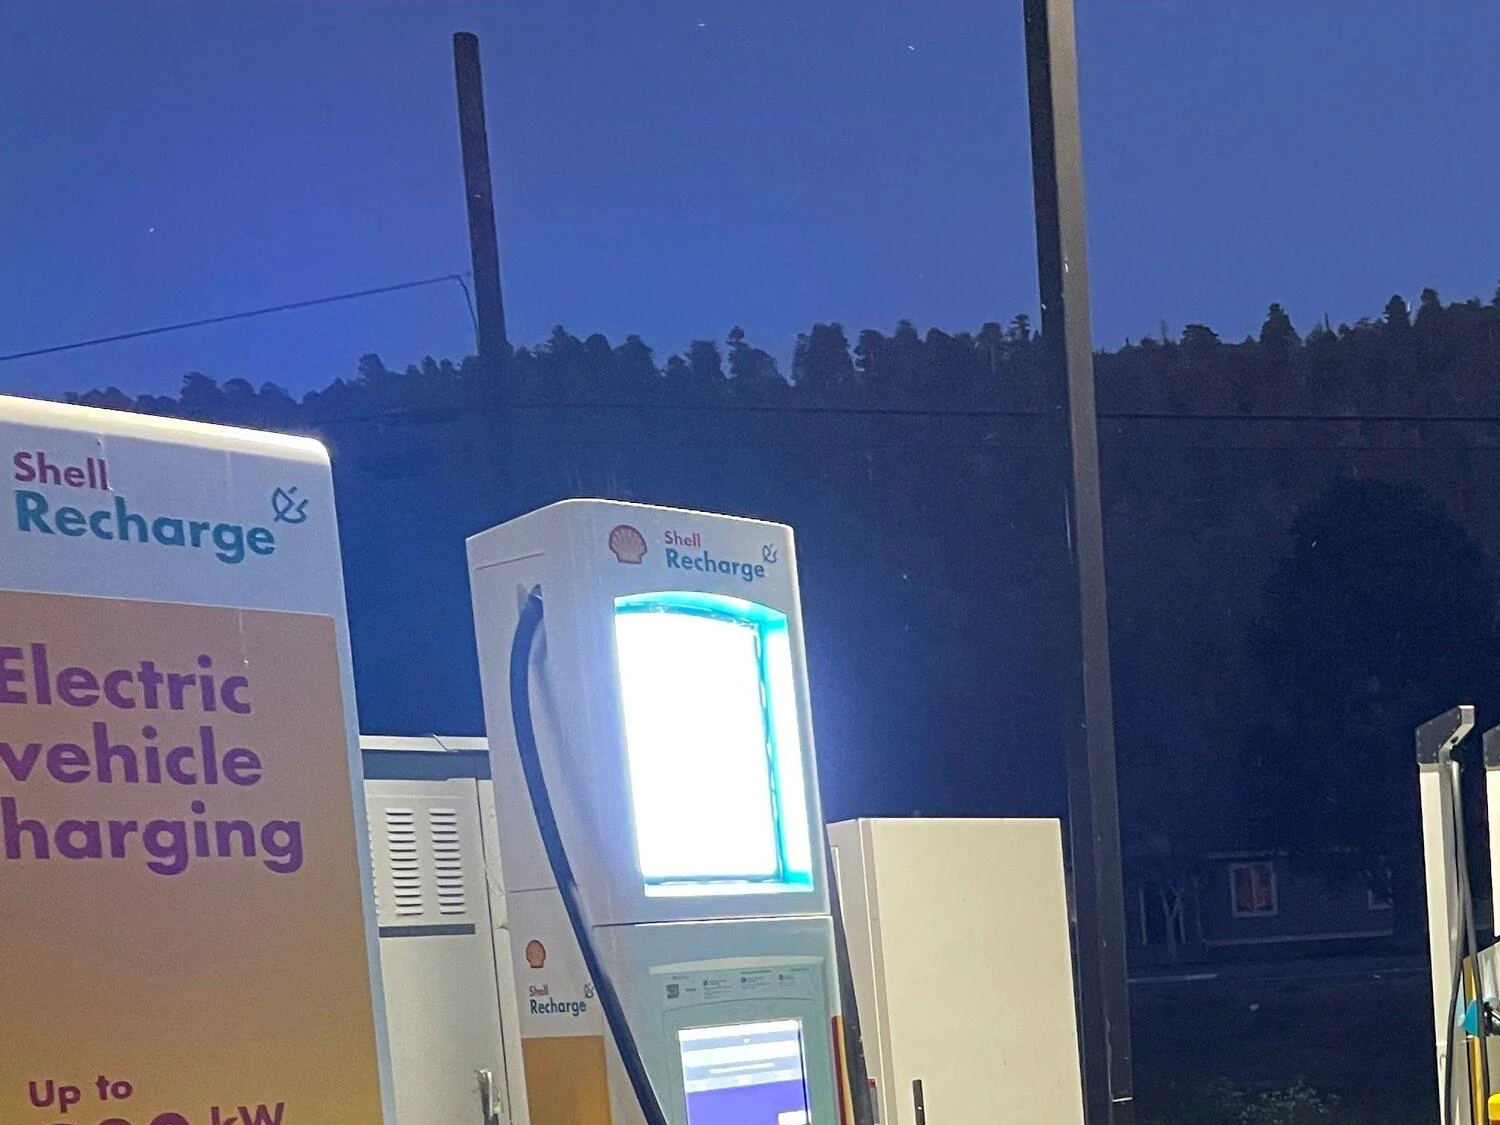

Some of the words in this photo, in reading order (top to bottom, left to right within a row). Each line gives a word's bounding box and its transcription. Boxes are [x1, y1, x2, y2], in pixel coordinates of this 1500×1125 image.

[13, 451, 109, 491] Shell
[14, 489, 276, 564] Recharge
[664, 530, 700, 547] Shell
[664, 547, 766, 582] Recharge
[0, 643, 252, 715] Electric
[0, 722, 262, 786] vehicle
[1, 796, 304, 876] harging
[528, 984, 549, 997] Shell
[529, 996, 587, 1017] Recharge
[28, 1079, 81, 1113] Up
[96, 1075, 133, 1101] to
